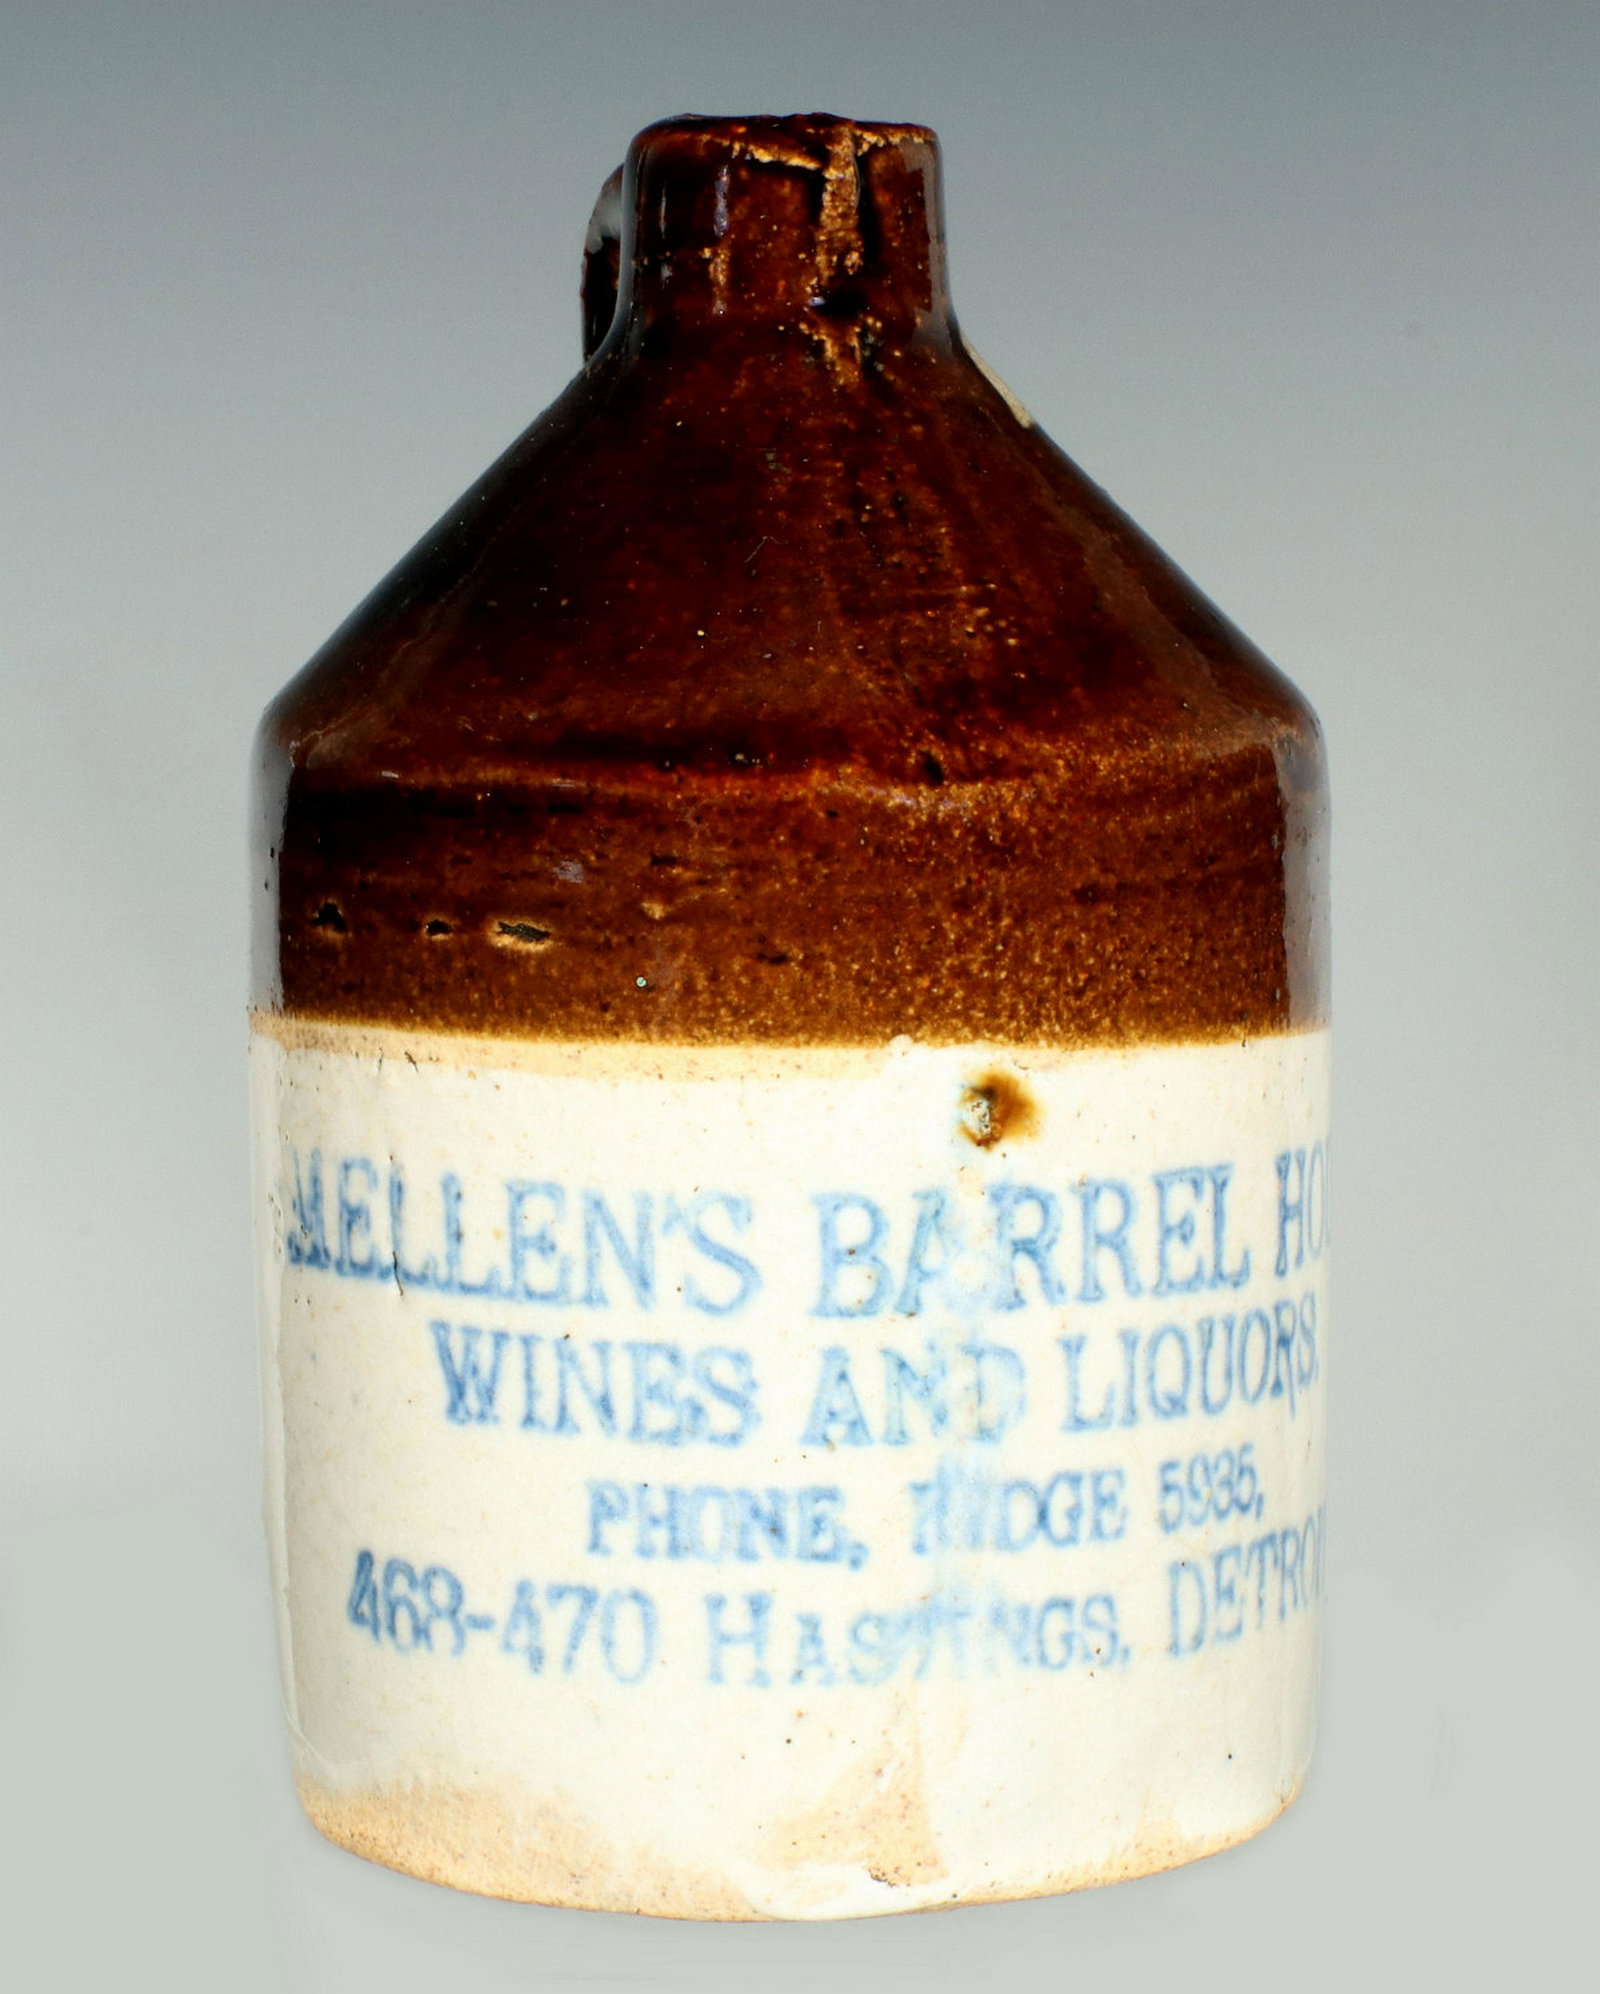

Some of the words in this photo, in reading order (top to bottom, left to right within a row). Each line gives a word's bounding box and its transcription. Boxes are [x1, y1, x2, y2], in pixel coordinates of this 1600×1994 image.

[287, 1146, 762, 1317] MELLEN'S
[808, 1162, 1252, 1318] BARREL
[429, 1319, 763, 1447] WINES
[799, 1336, 1028, 1447] AND
[347, 1549, 659, 1685] 468-470
